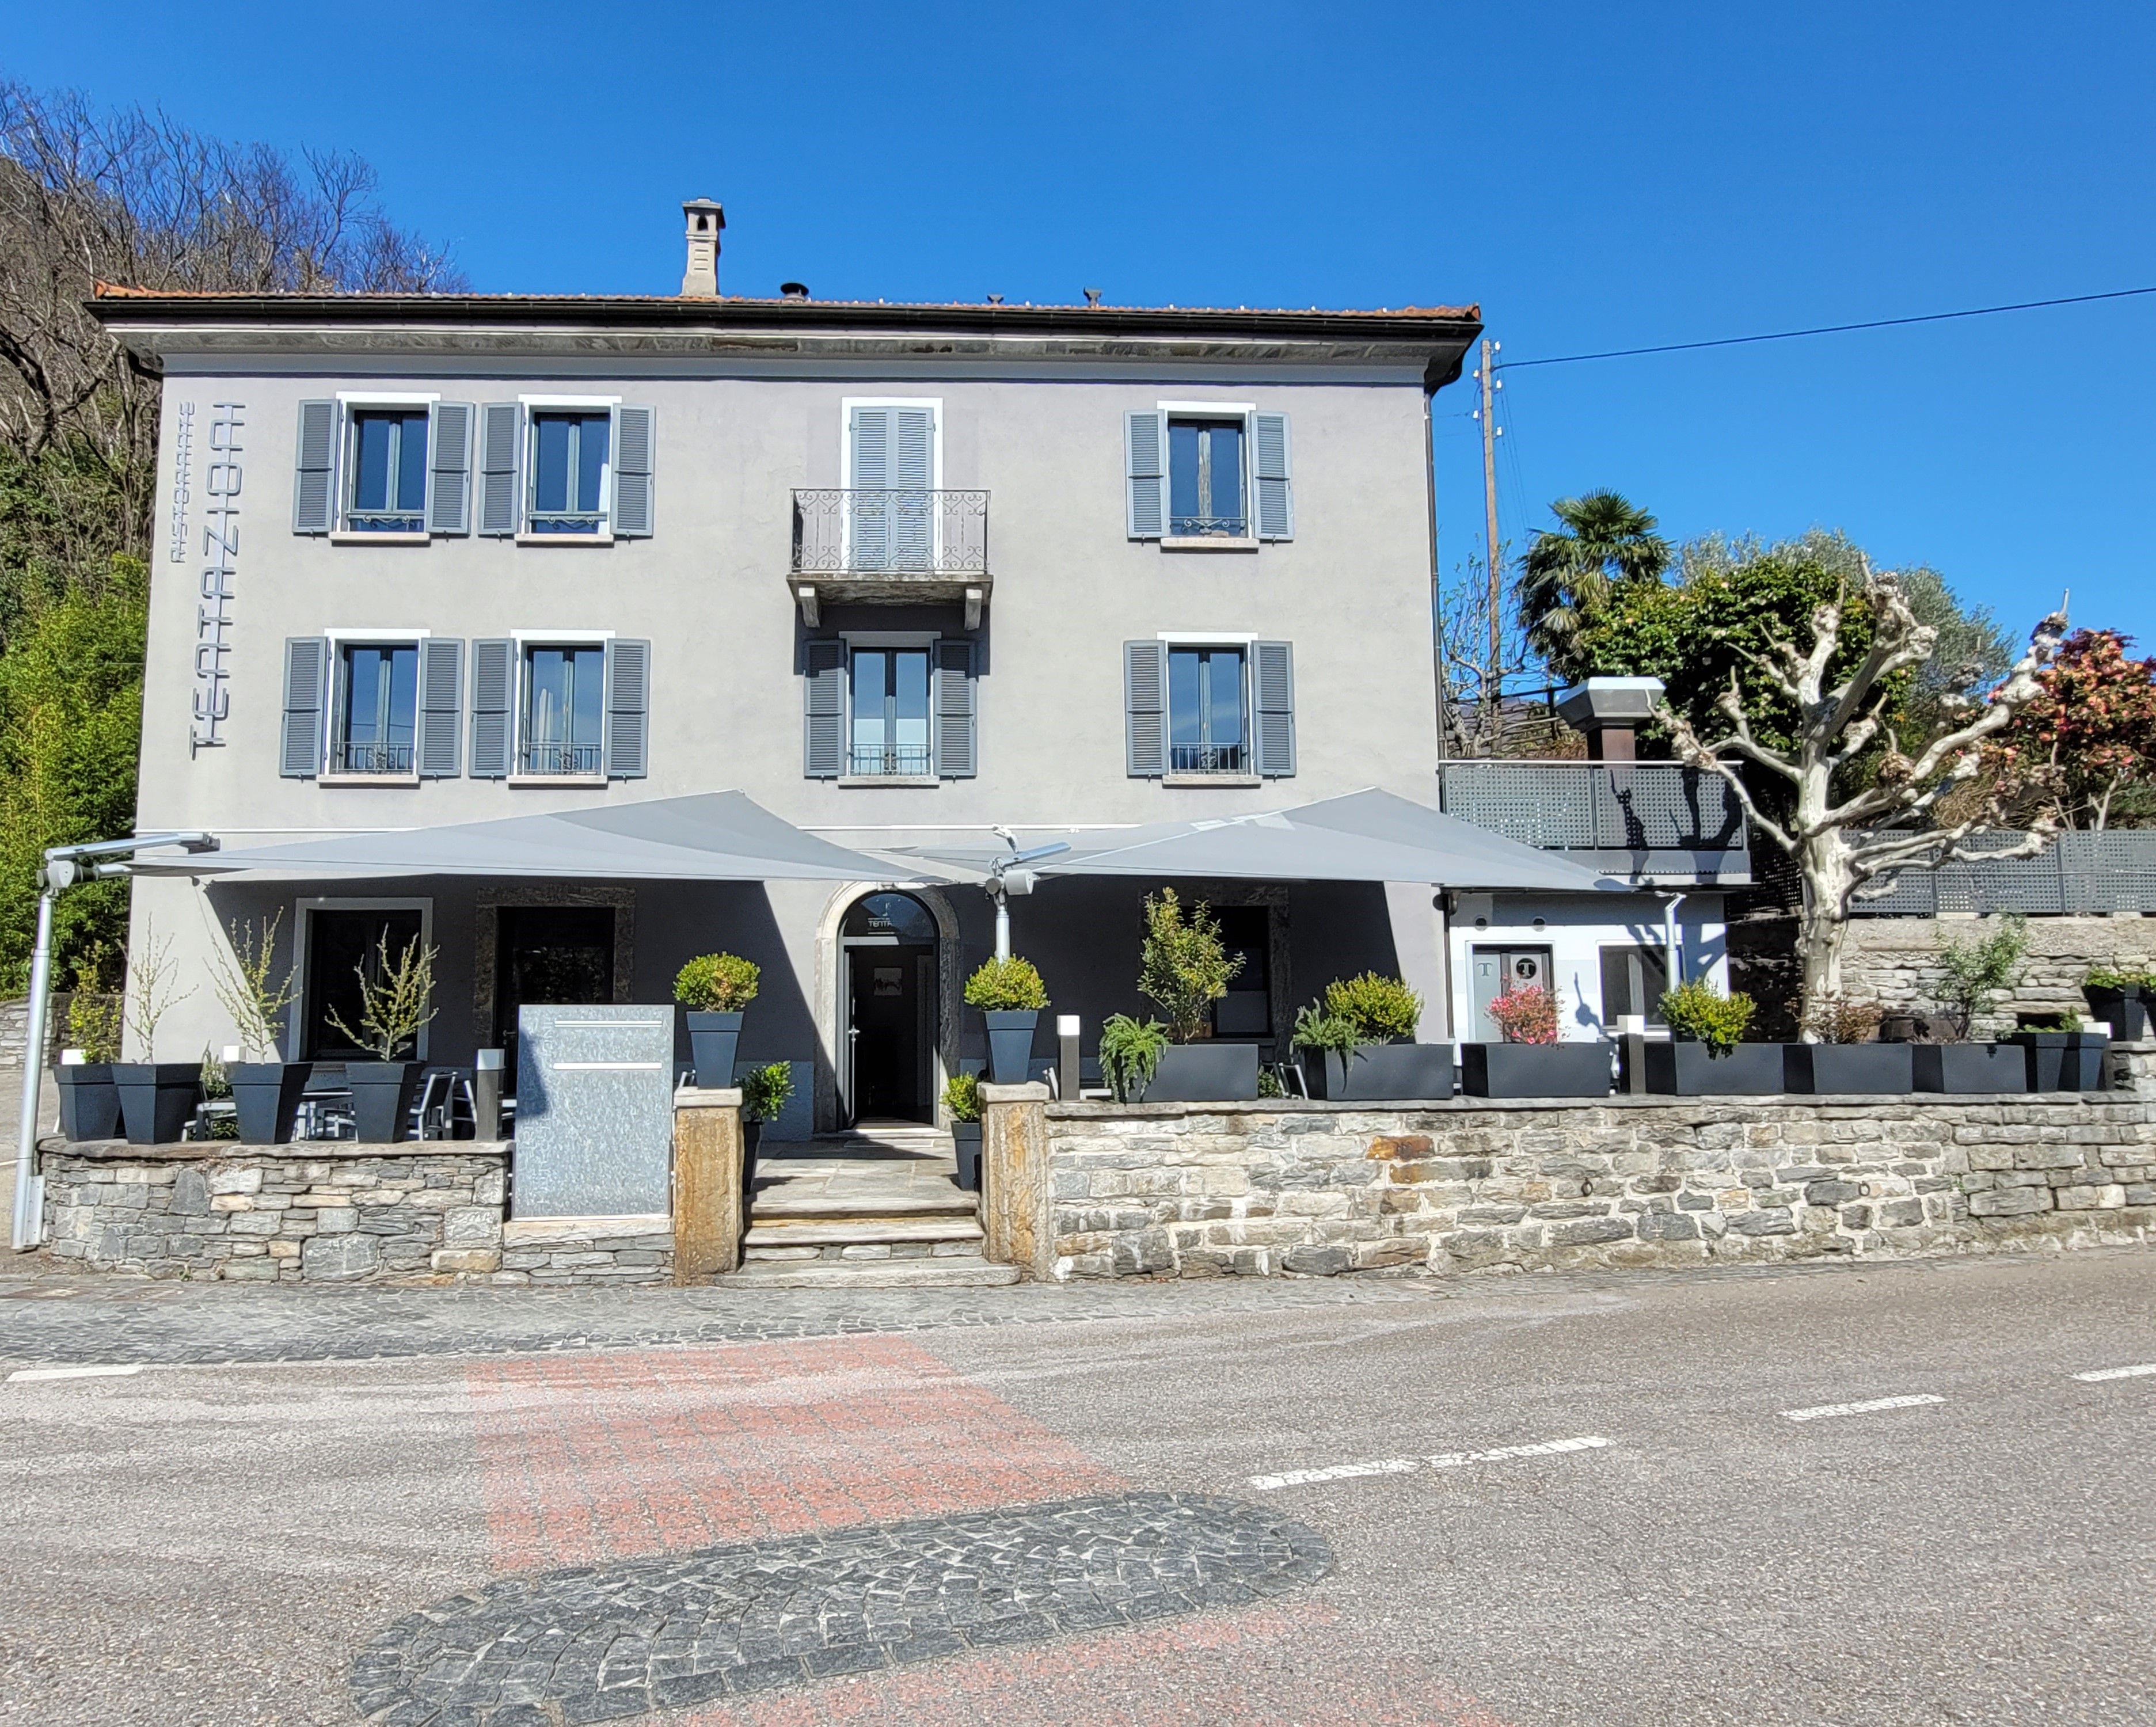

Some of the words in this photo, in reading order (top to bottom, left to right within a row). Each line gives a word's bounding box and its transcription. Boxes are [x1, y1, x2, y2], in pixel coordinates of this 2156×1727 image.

[170, 401, 195, 563] RISTORANTE
[189, 401, 246, 759] TENTAZIONI
[1477, 962, 1493, 976] T
[1518, 962, 1535, 977] T
